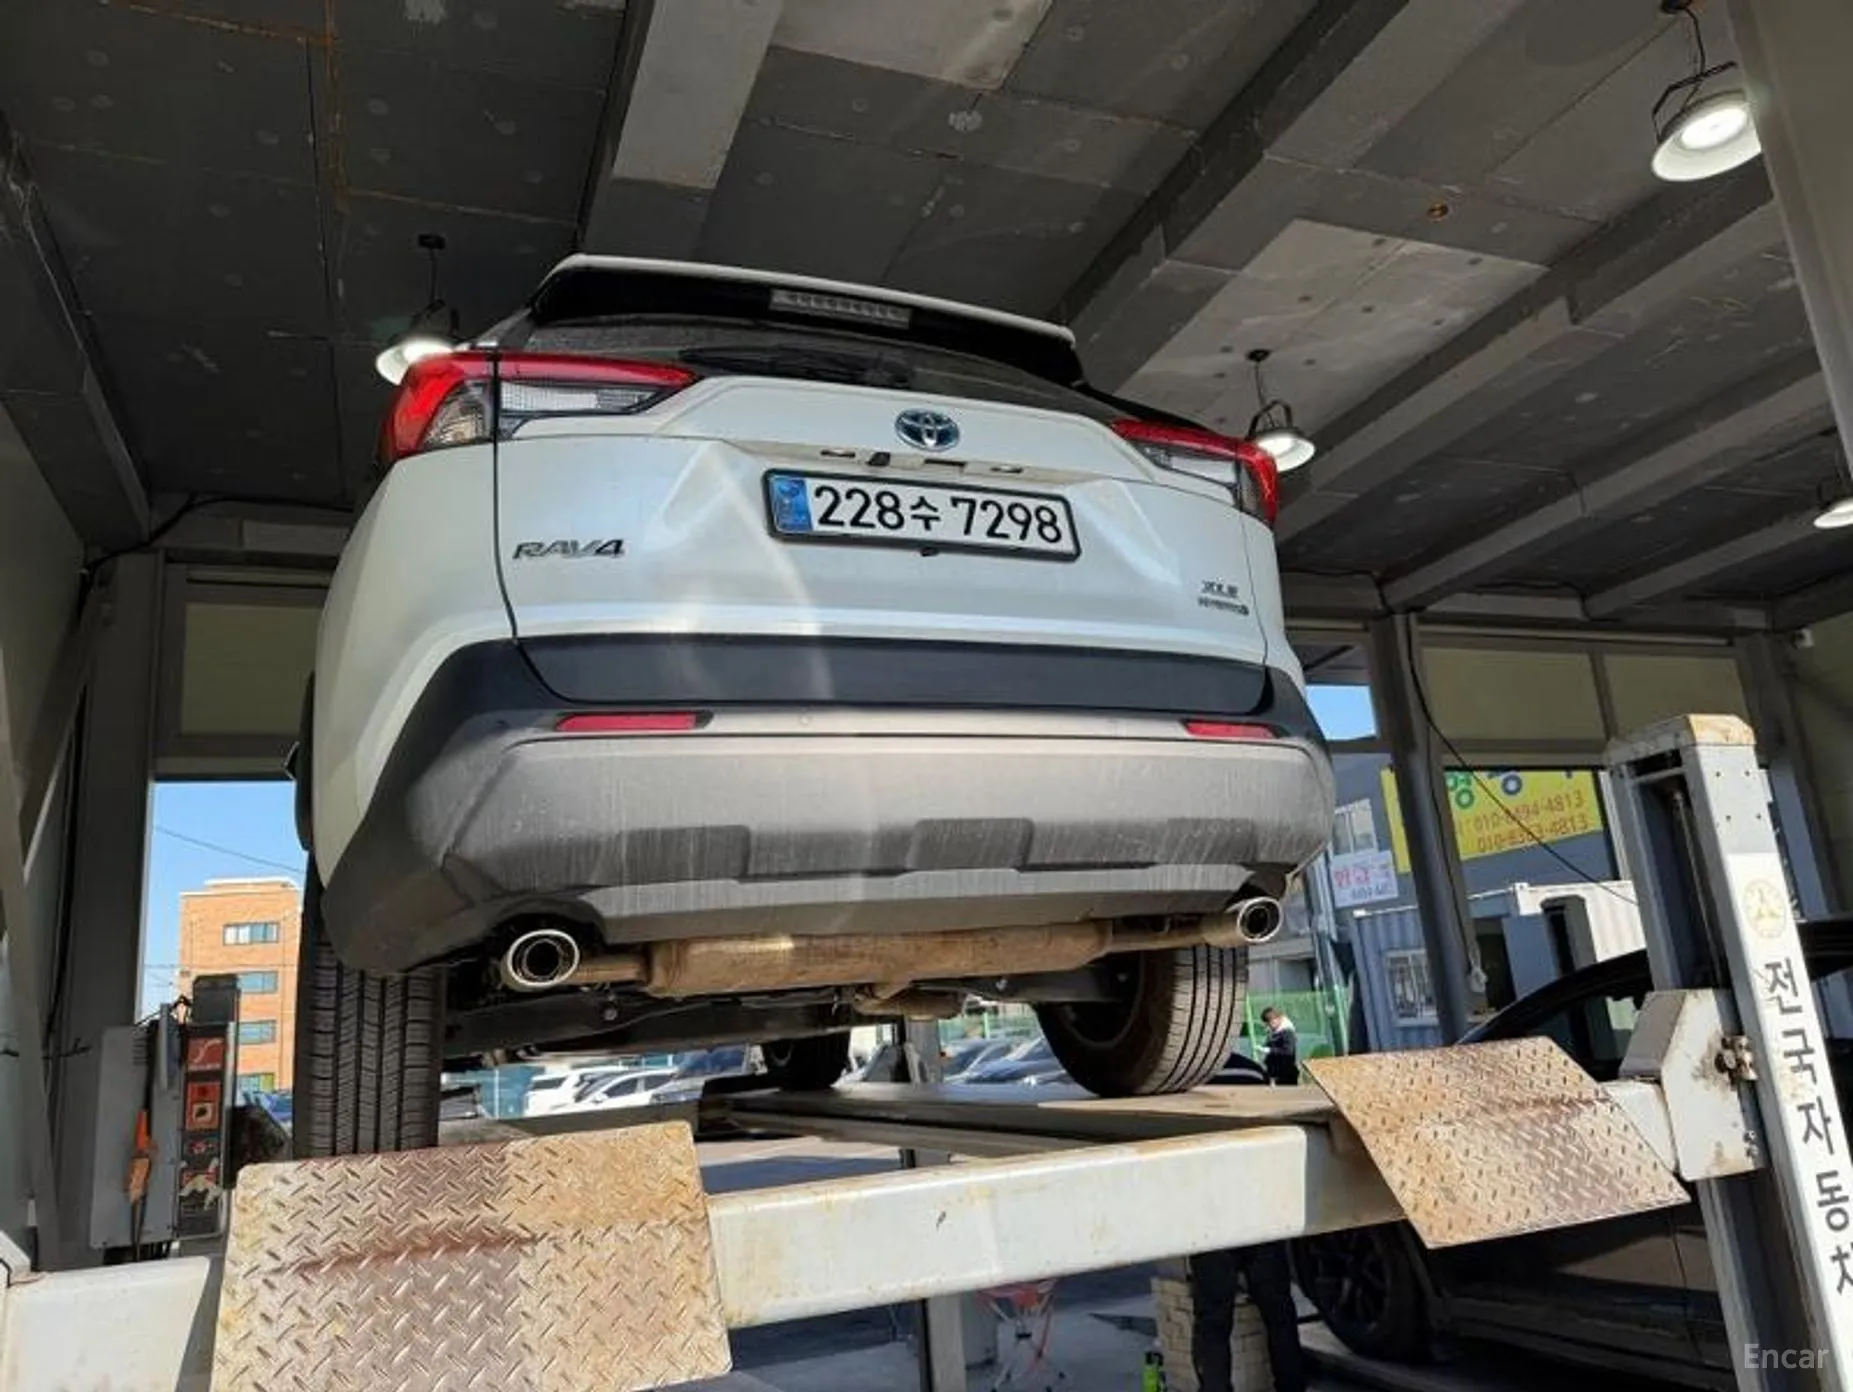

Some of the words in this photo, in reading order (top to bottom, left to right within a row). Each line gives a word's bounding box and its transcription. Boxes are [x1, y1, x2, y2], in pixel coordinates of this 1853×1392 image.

[813, 485, 941, 531] 228수
[951, 495, 1063, 544] 7298
[511, 539, 624, 560] RAV4
